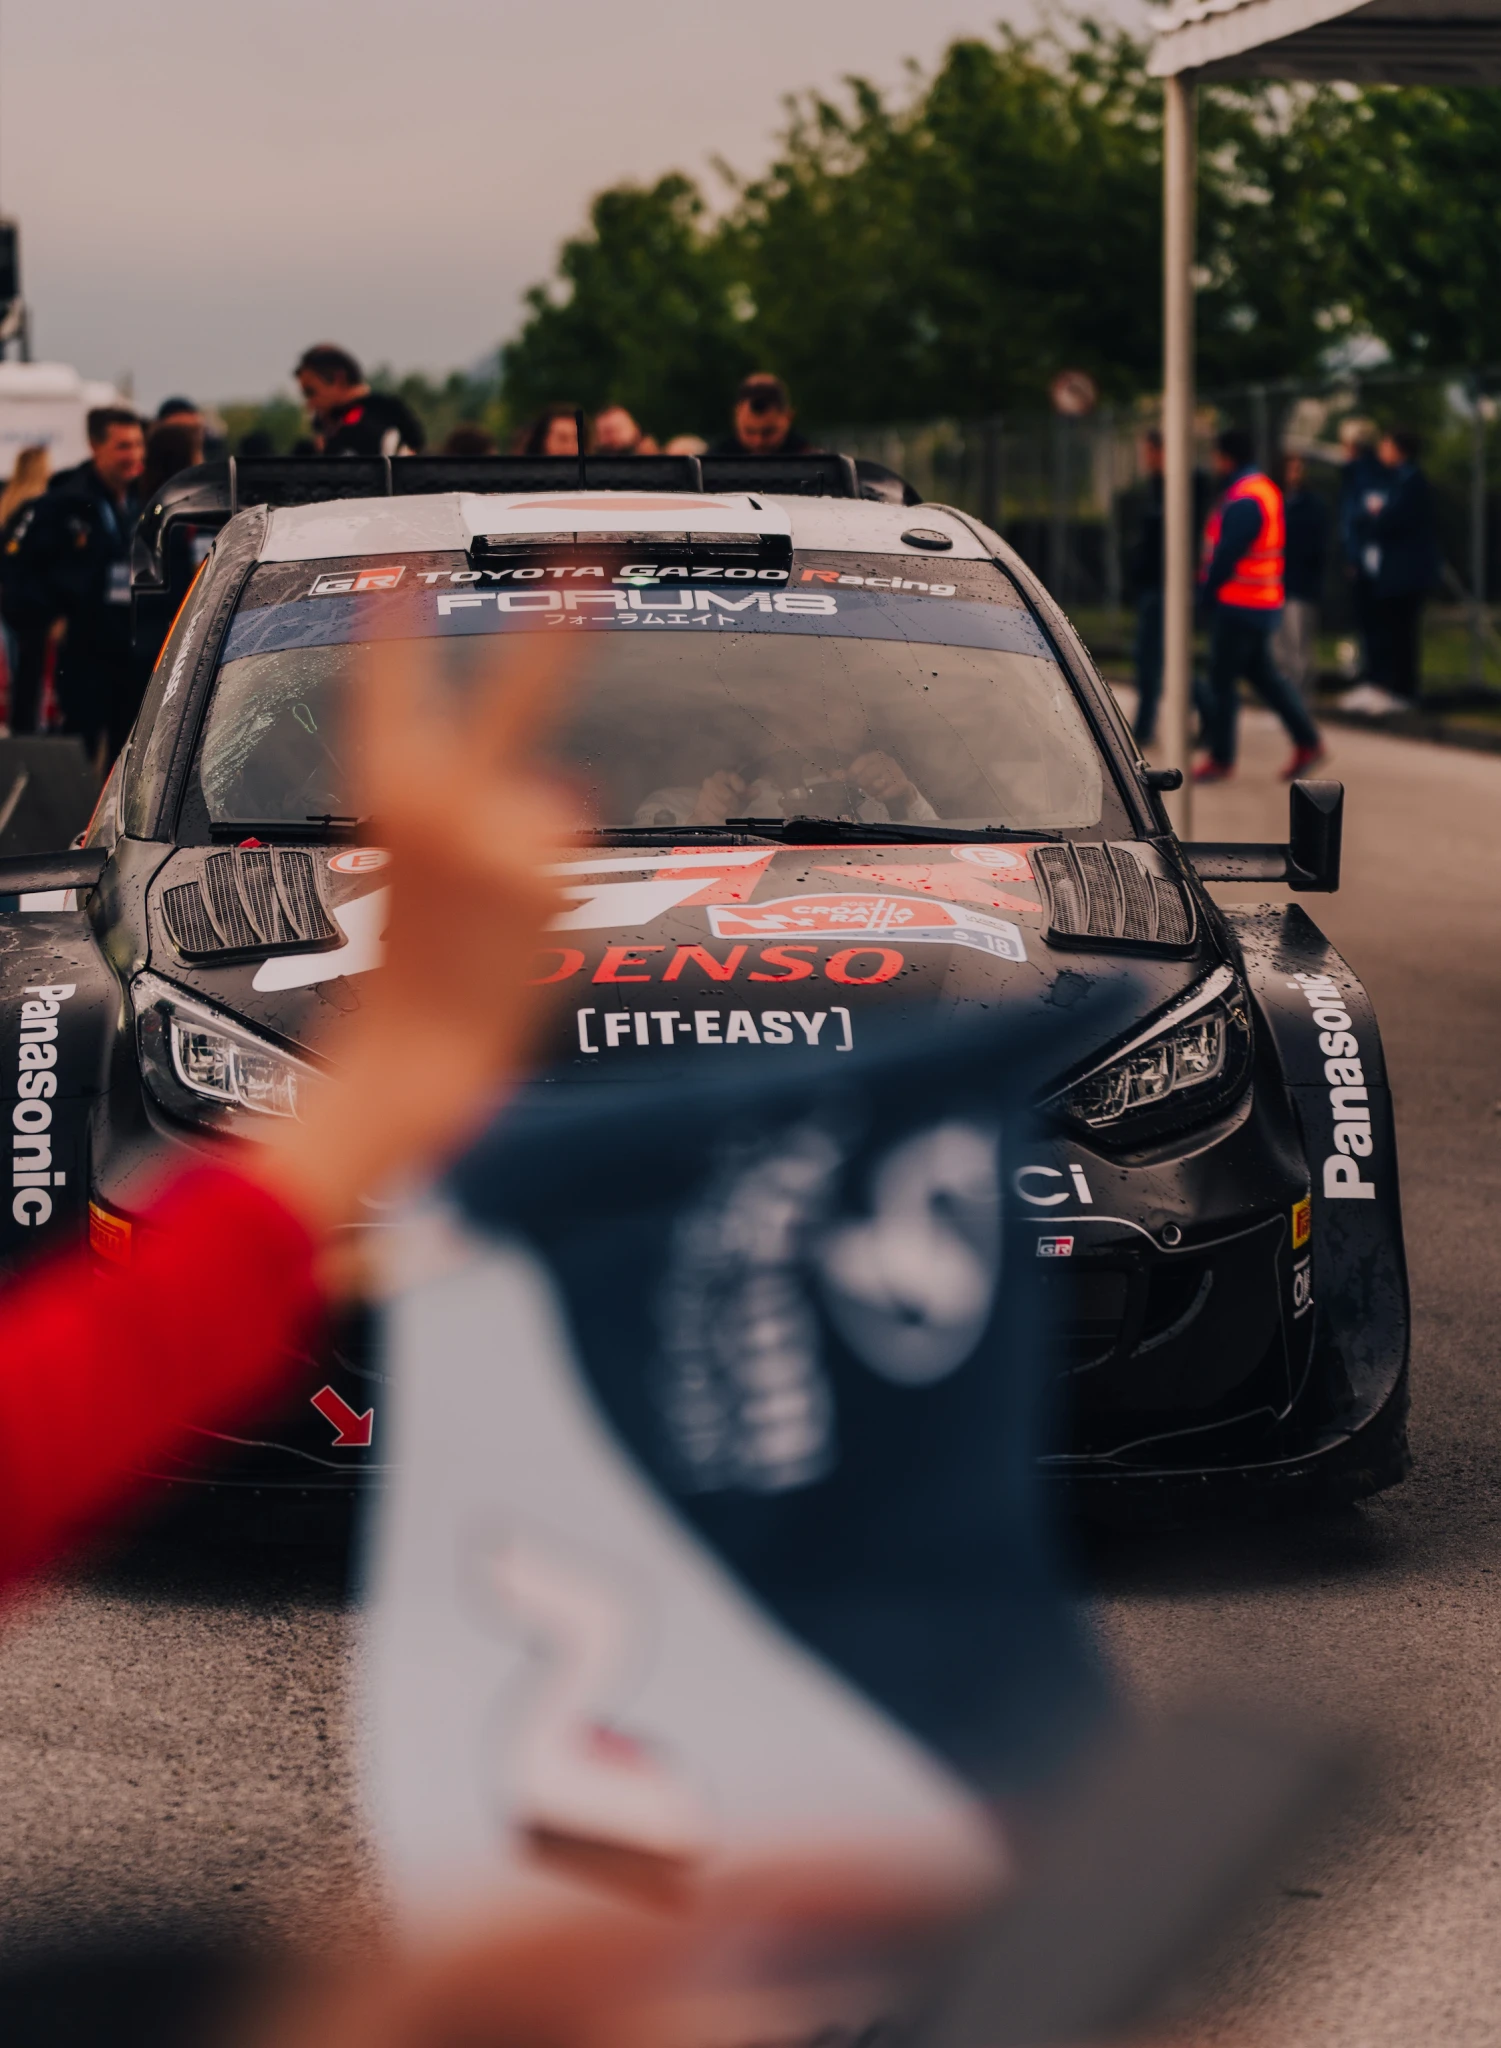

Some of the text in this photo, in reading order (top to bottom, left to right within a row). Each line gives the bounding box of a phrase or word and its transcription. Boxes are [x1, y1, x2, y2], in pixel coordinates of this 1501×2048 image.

[313, 573, 398, 594] GR
[417, 565, 957, 596] TOYOTA GAZOO Racing
[437, 589, 838, 616] FORUM8
[544, 613, 736, 626] フォーラムエイト
[983, 934, 1011, 955] 18
[1285, 973, 1376, 1199] Panasonic
[12, 984, 76, 1226] Panasonic
[1038, 1241, 1072, 1256] GR
